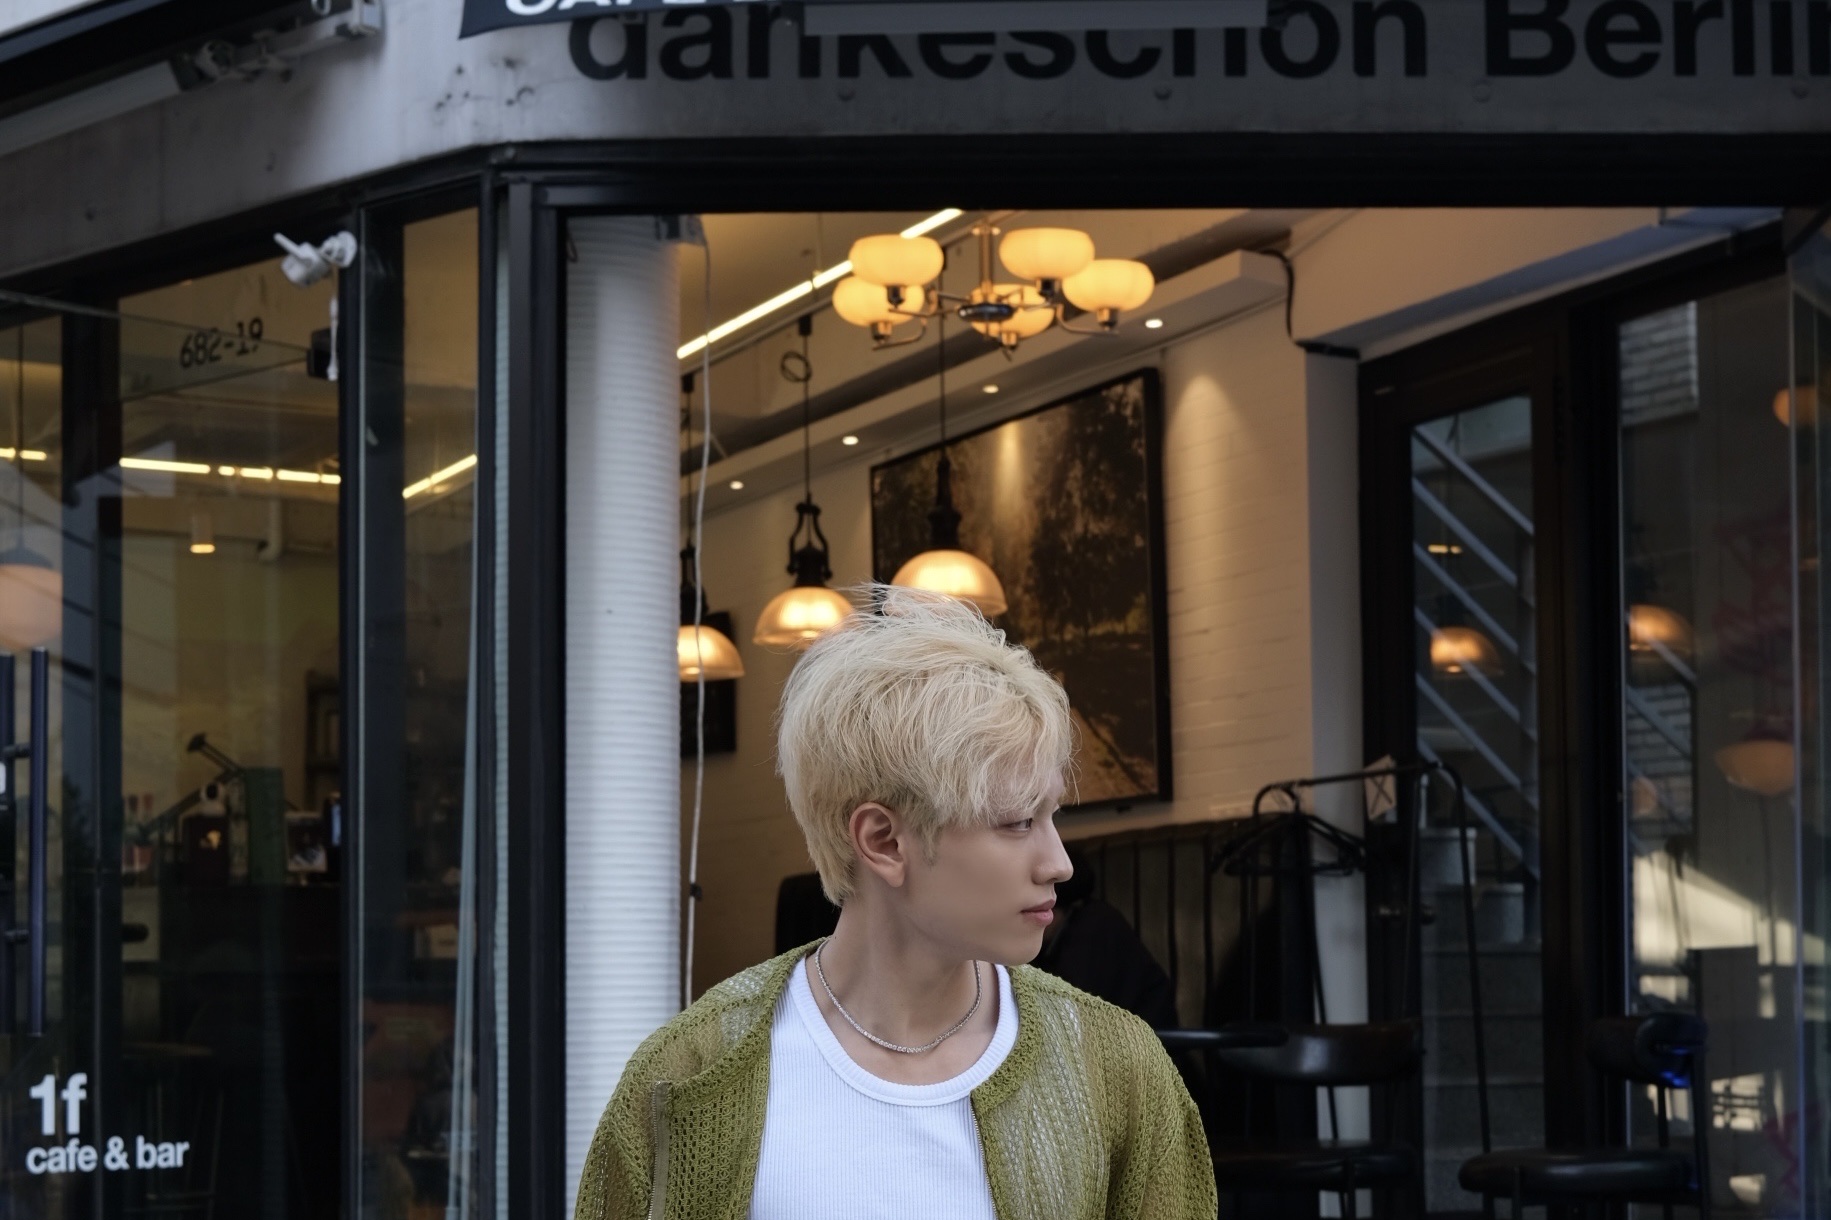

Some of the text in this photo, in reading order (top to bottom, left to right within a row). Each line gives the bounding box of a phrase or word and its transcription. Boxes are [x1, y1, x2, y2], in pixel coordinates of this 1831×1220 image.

[180, 316, 263, 368] 682-19
[30, 1072, 88, 1136] 1f
[26, 1135, 190, 1174] cafe & bar
